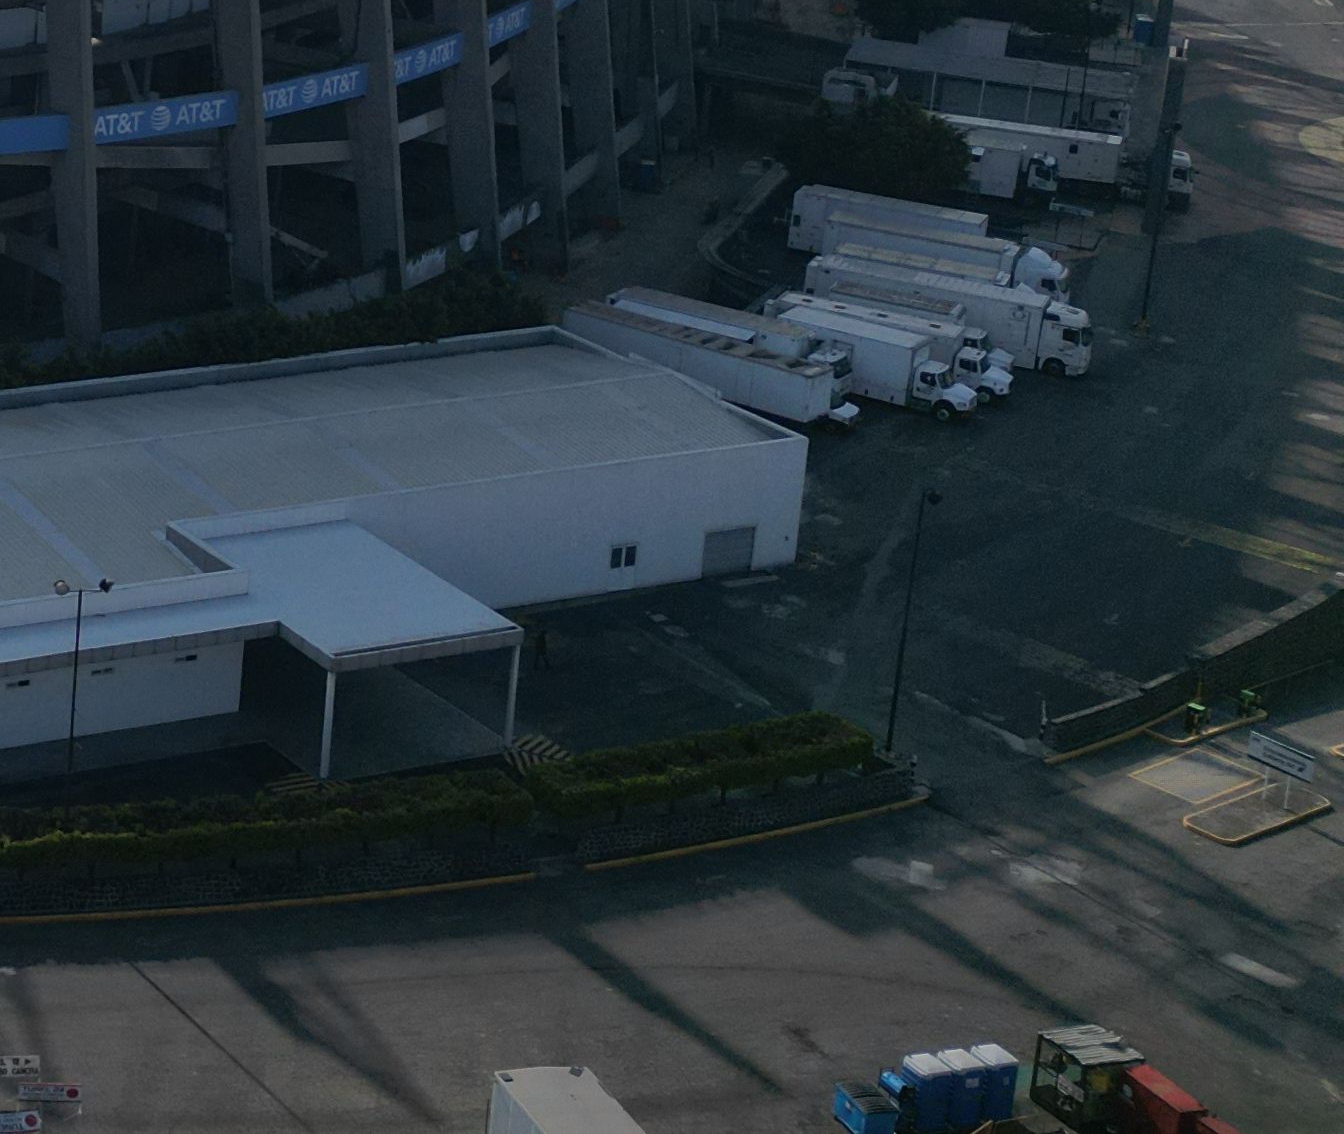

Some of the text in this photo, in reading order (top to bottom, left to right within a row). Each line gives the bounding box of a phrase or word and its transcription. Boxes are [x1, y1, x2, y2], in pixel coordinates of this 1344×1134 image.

[428, 39, 457, 69] AT&T
[320, 70, 360, 99] AT&T
[94, 98, 227, 137] AT&T AT&T
